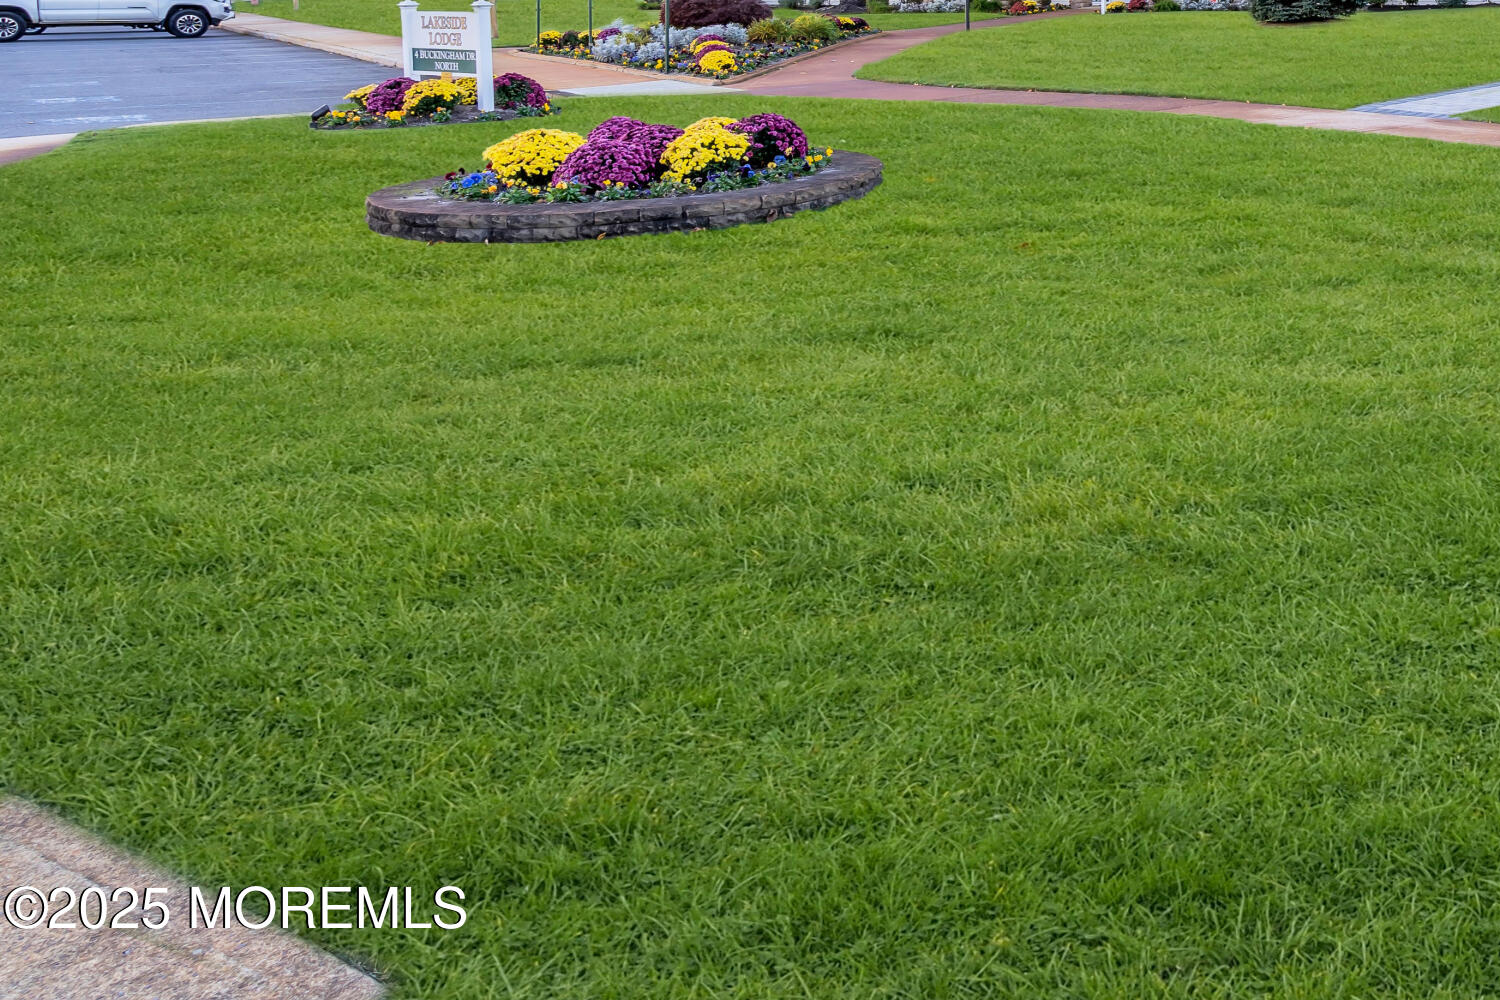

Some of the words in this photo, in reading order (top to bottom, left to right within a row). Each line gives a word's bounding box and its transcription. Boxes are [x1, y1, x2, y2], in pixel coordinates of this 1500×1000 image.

[421, 15, 467, 30] LAKESIDE
[429, 32, 462, 46] LODGE
[414, 50, 419, 59] 4
[419, 50, 465, 60] BUCKINGHAM
[434, 61, 459, 71] NORTH
